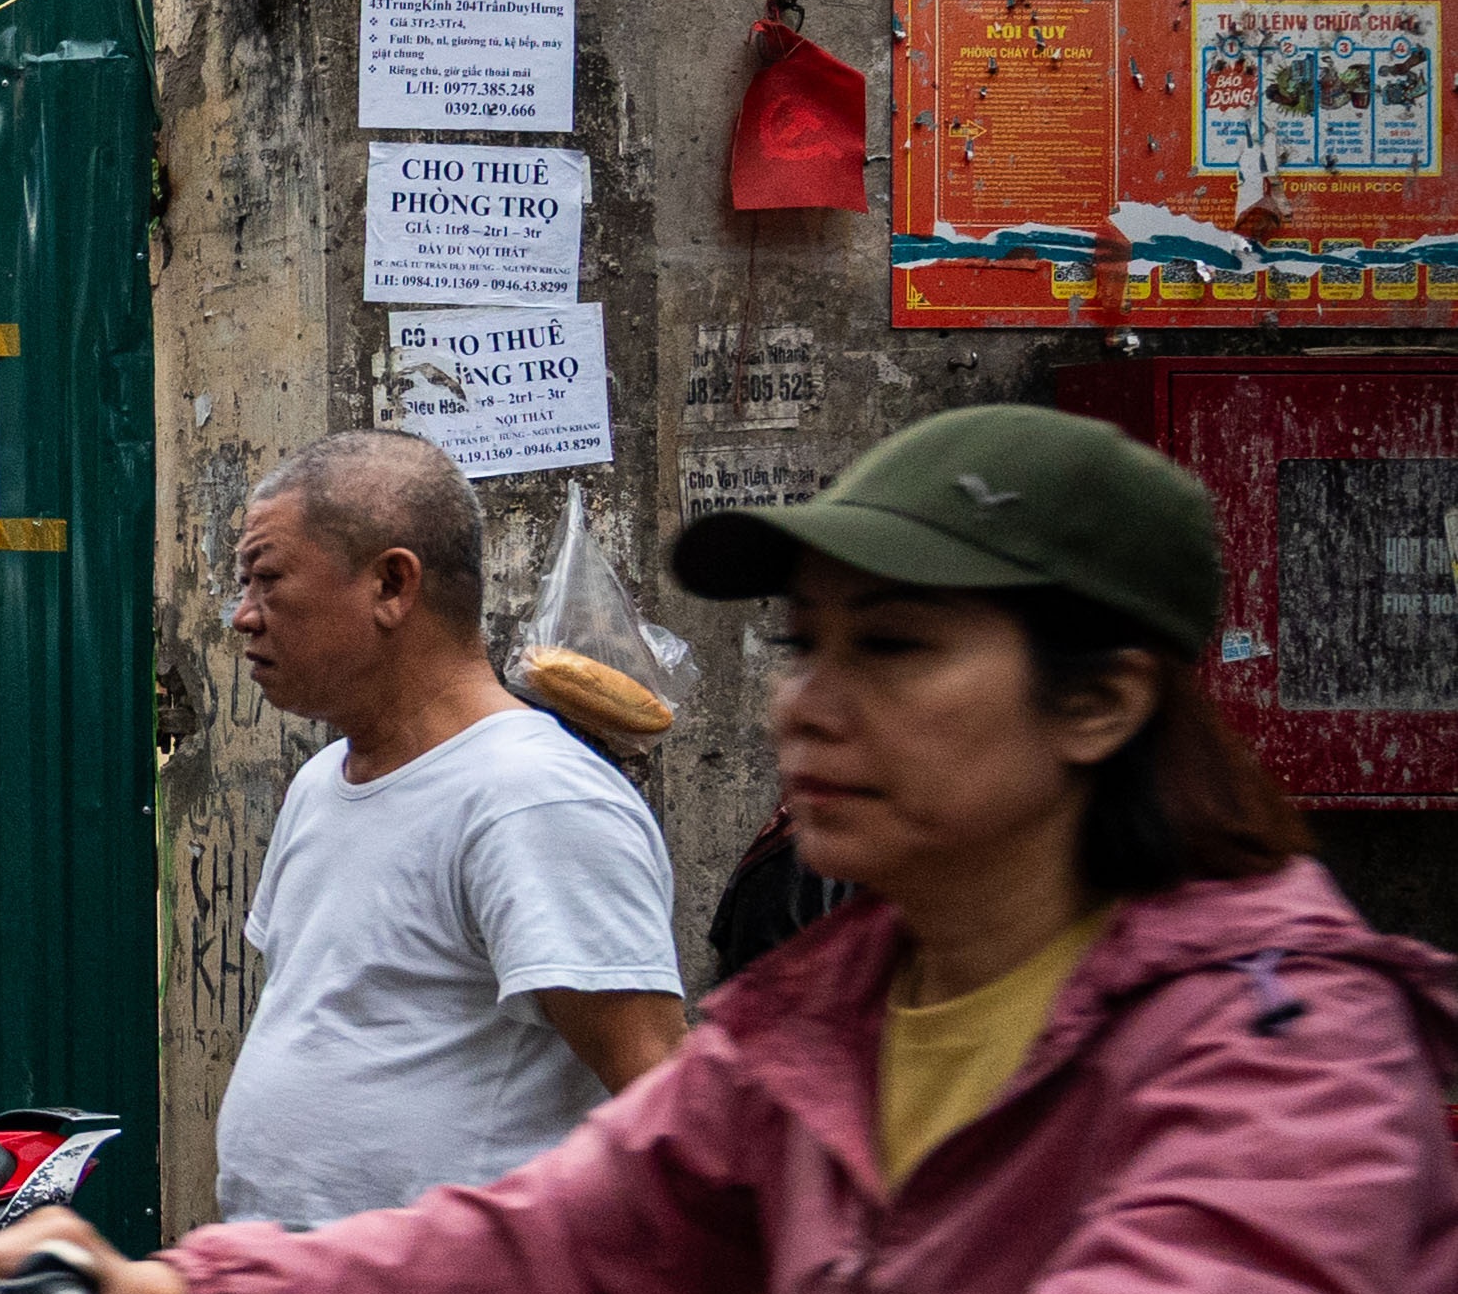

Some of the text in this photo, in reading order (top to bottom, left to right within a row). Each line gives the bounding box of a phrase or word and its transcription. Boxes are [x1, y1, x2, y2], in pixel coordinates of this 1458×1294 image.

[393, 49, 424, 60] chung
[443, 82, 535, 97] 0977.385.248
[402, 158, 549, 185] CHO THUÊ
[391, 187, 559, 224] PHÒNG TRỌ
[487, 318, 565, 354] THUÊ
[518, 357, 579, 384] TRỌ
